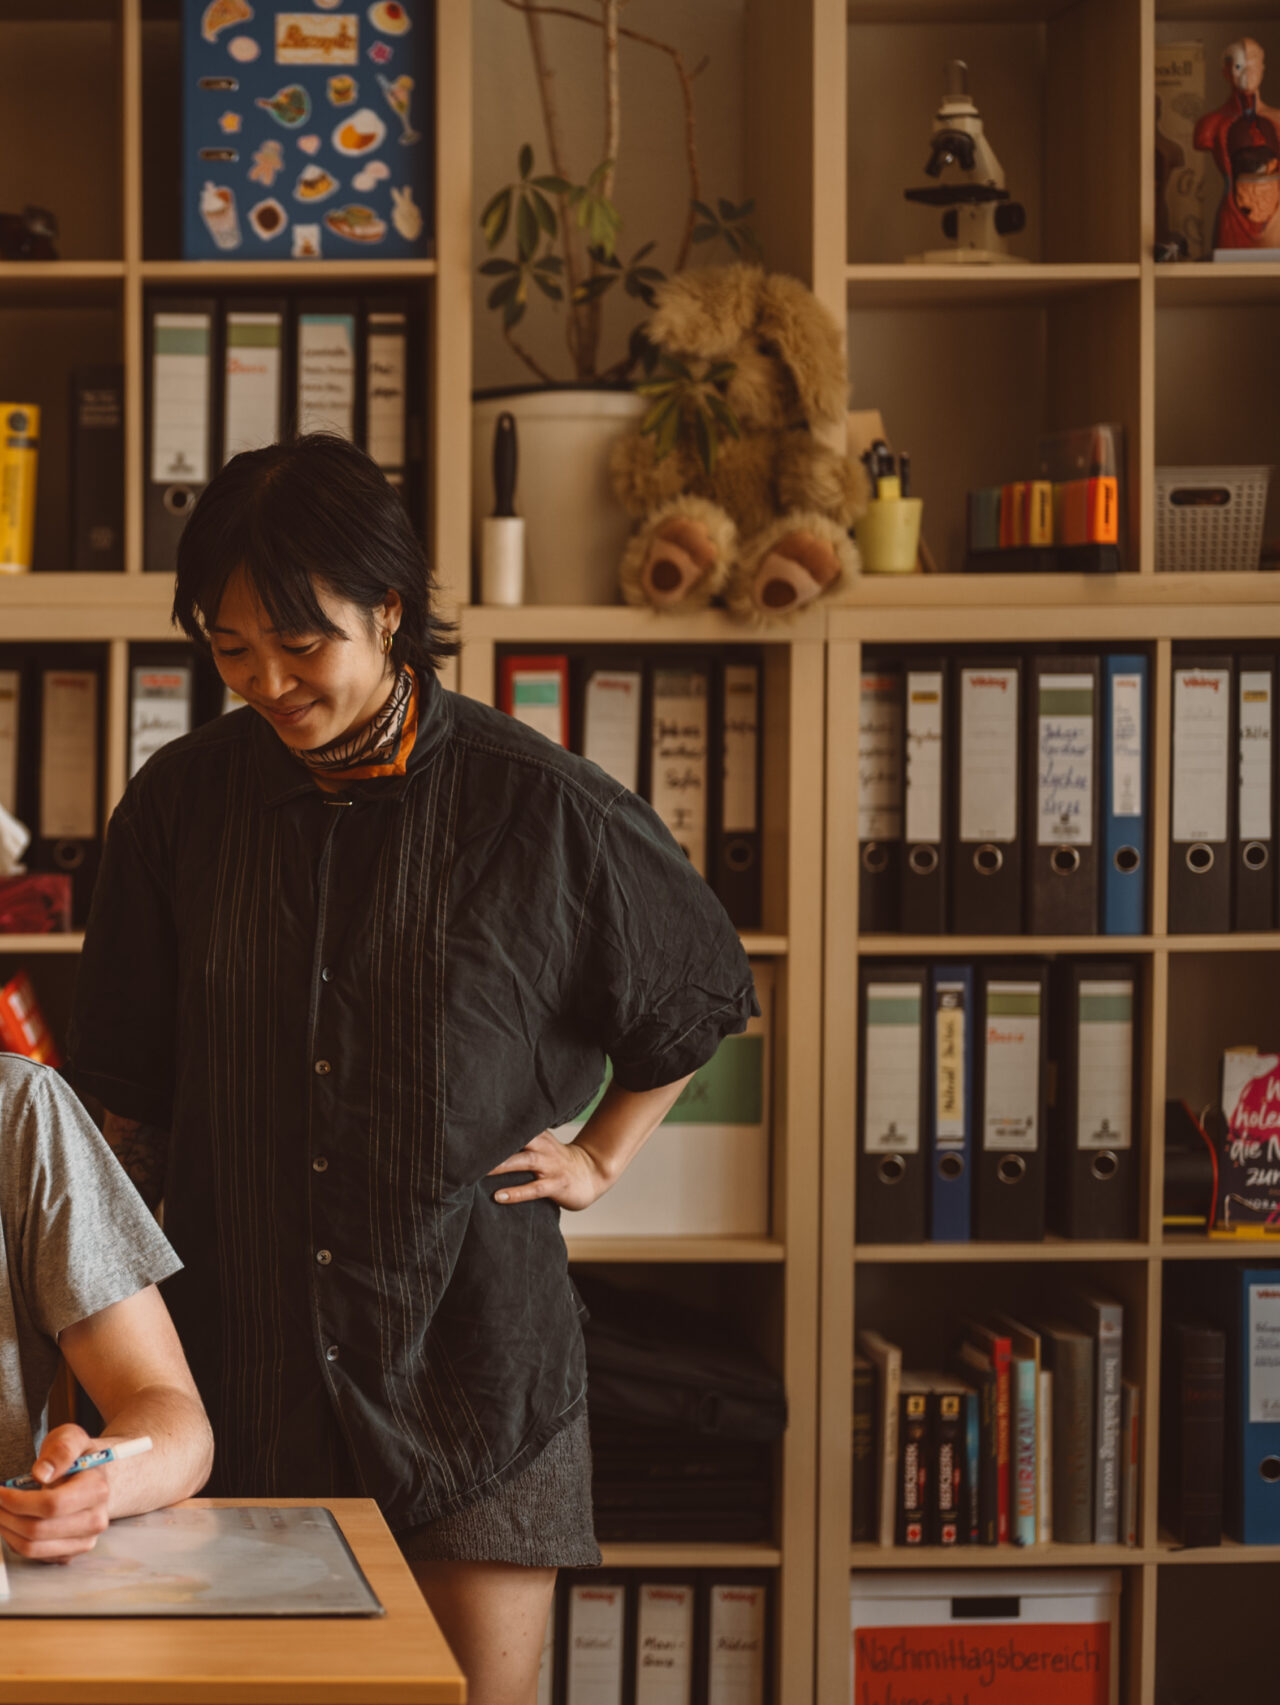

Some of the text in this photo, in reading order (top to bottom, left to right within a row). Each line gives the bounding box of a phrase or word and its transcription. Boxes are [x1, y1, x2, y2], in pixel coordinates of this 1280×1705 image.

[1230, 1130, 1262, 1167] die
[1098, 1357, 1120, 1509] how baking works
[858, 1636, 1101, 1688] Nachmittagsbereich
